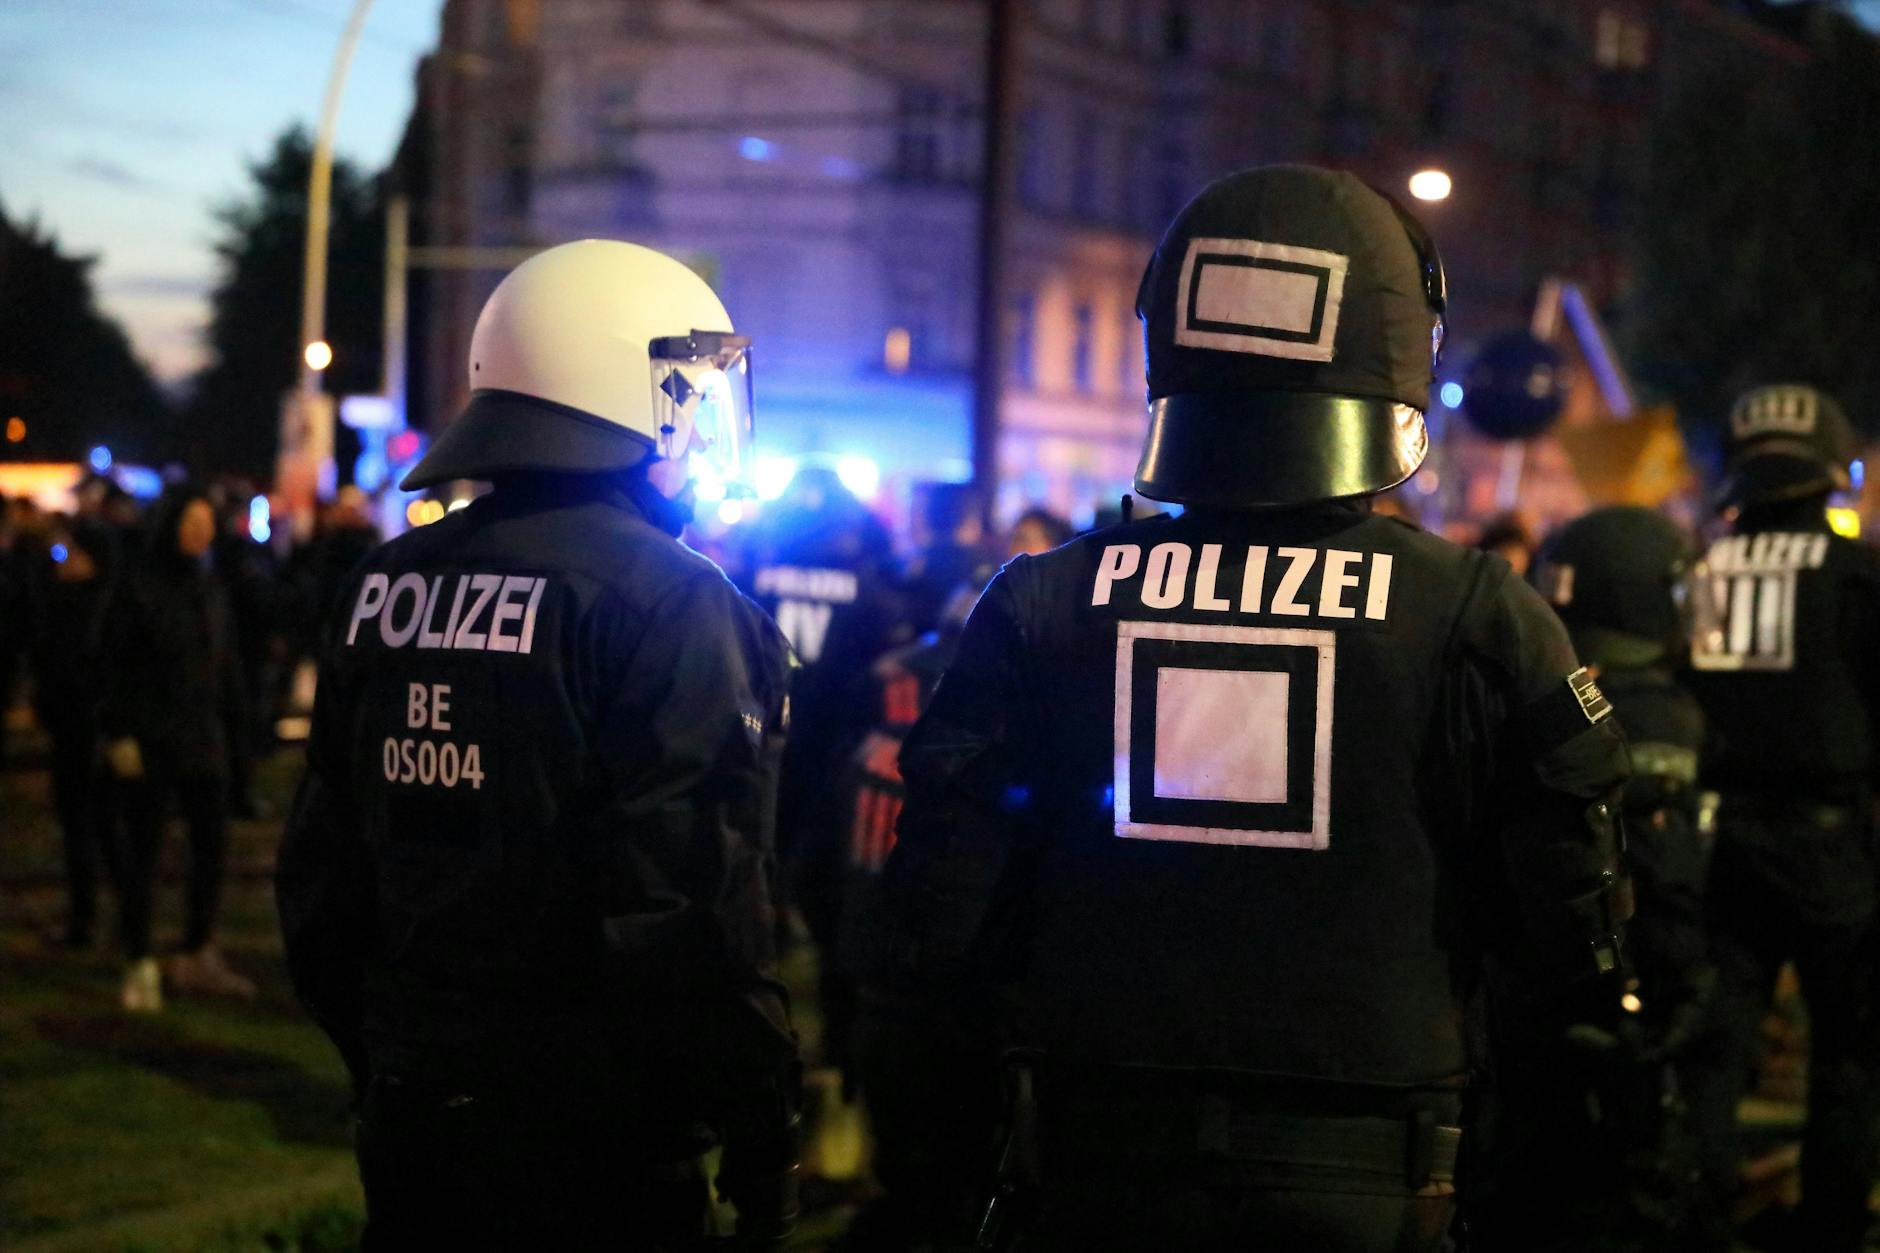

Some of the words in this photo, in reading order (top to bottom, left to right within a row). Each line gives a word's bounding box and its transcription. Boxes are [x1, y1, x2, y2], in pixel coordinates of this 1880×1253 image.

[346, 572, 548, 655] POLIZEI
[1091, 542, 1394, 621] POLIZEI
[407, 682, 451, 731] BE
